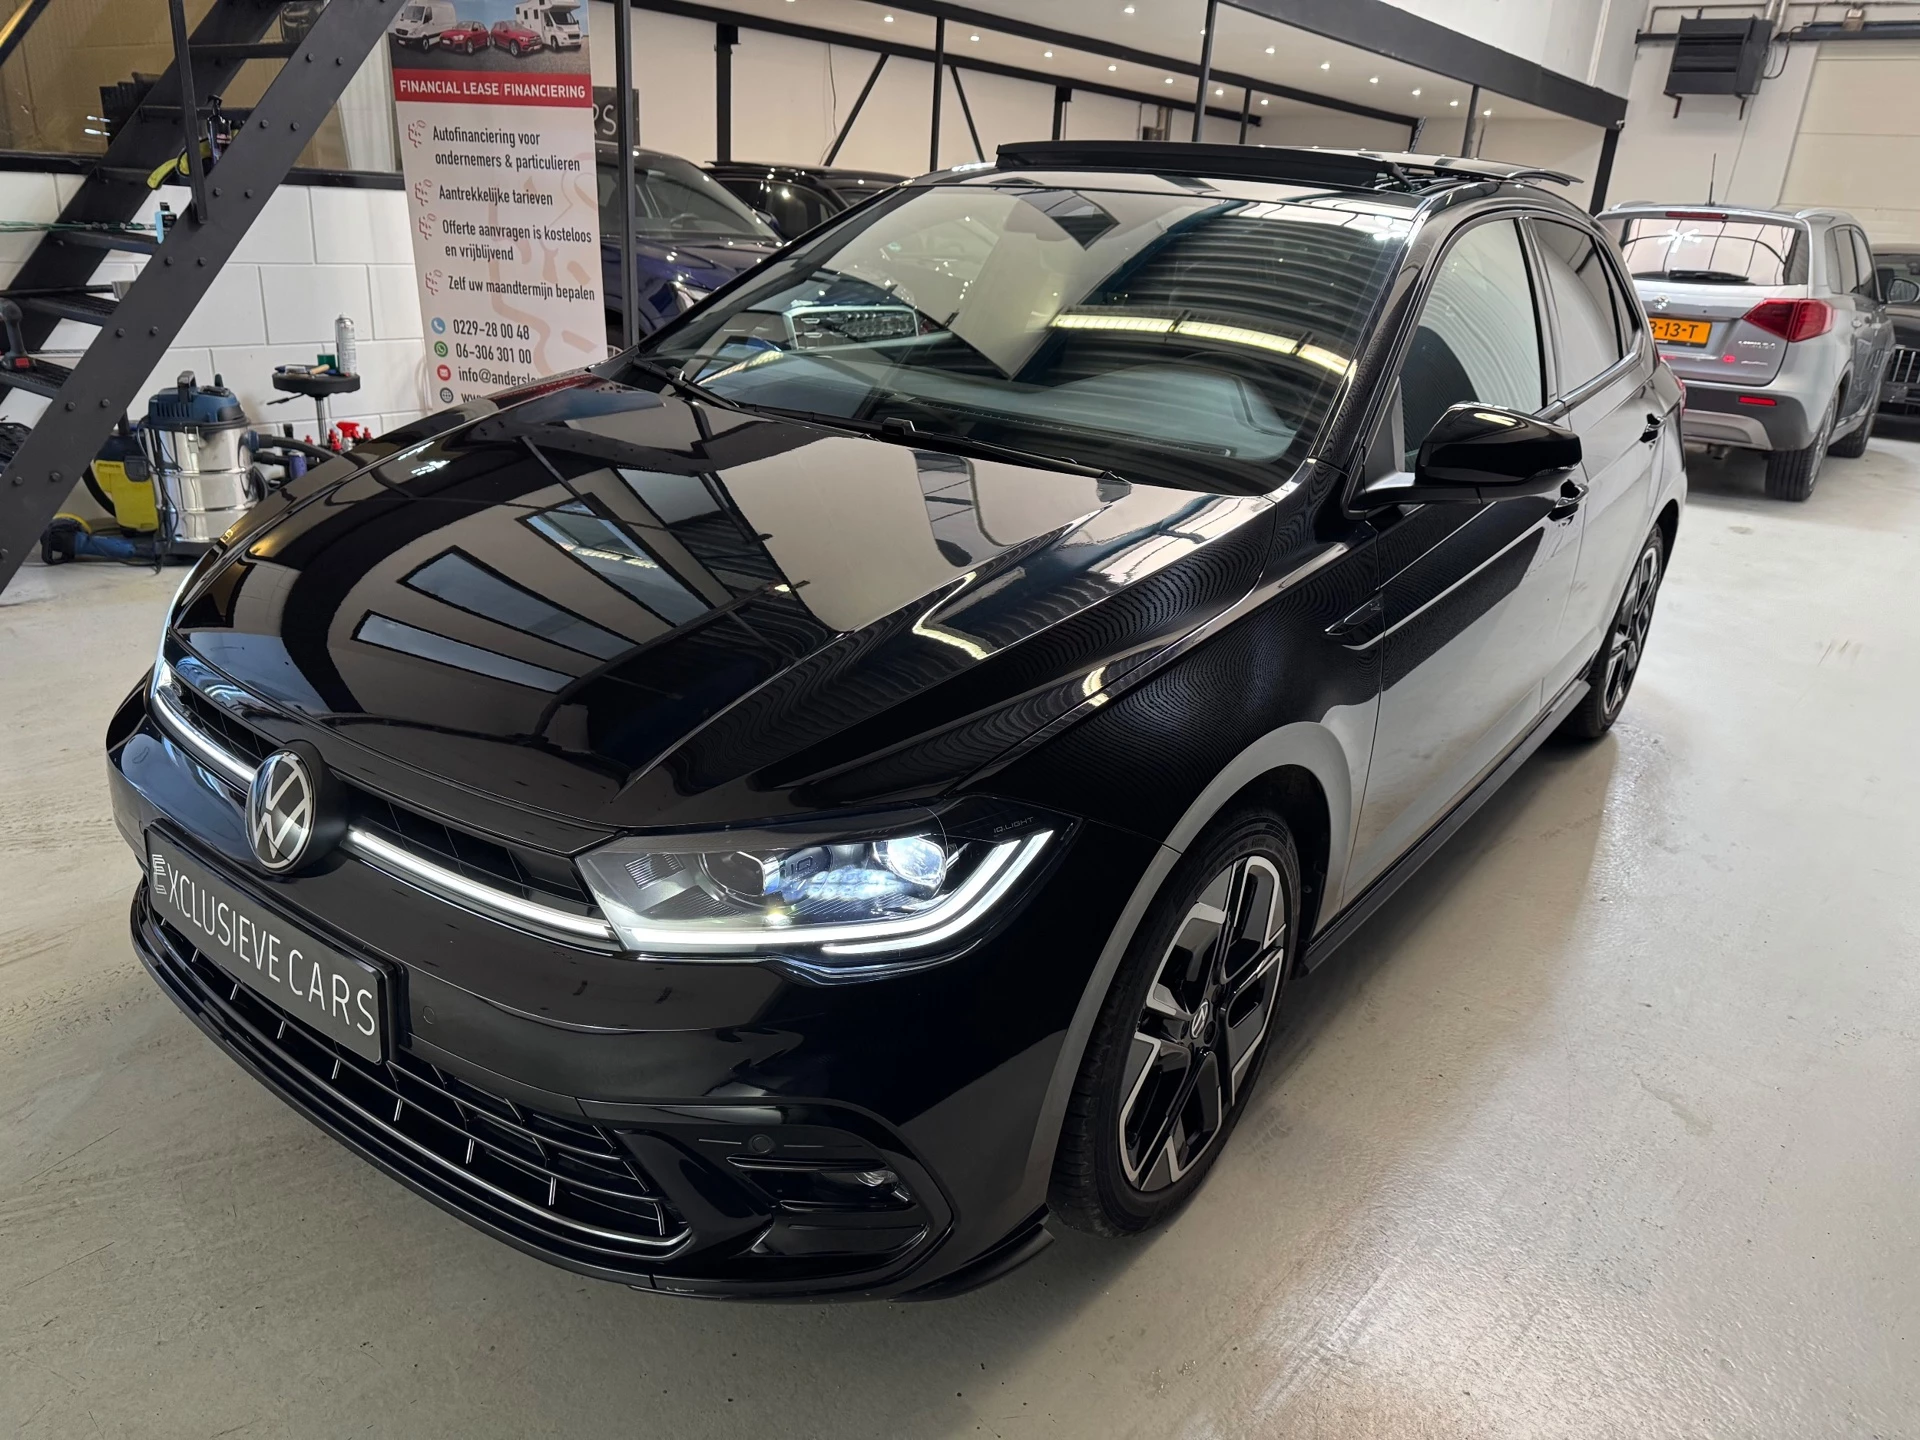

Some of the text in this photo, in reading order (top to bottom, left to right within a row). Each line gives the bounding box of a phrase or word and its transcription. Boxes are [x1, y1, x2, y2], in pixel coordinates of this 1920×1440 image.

[400, 79, 586, 99] FINANCIAL LEASE FINANCIERING
[433, 125, 540, 148] Autofinanciering voor
[435, 150, 580, 172] ondernemers & particulieren
[439, 184, 553, 206] Aantrekkelijke tarieven
[442, 219, 592, 243] Offerte aanvragen is kosteloos
[445, 243, 514, 262] en vrijblijvend
[448, 275, 595, 302] Zelf uw maandtermijn bepalen
[453, 319, 530, 341] 0229-28 00 48
[456, 343, 532, 364] 06-306 301 00
[152, 853, 375, 1036] EXCLUSIEVE CARS
